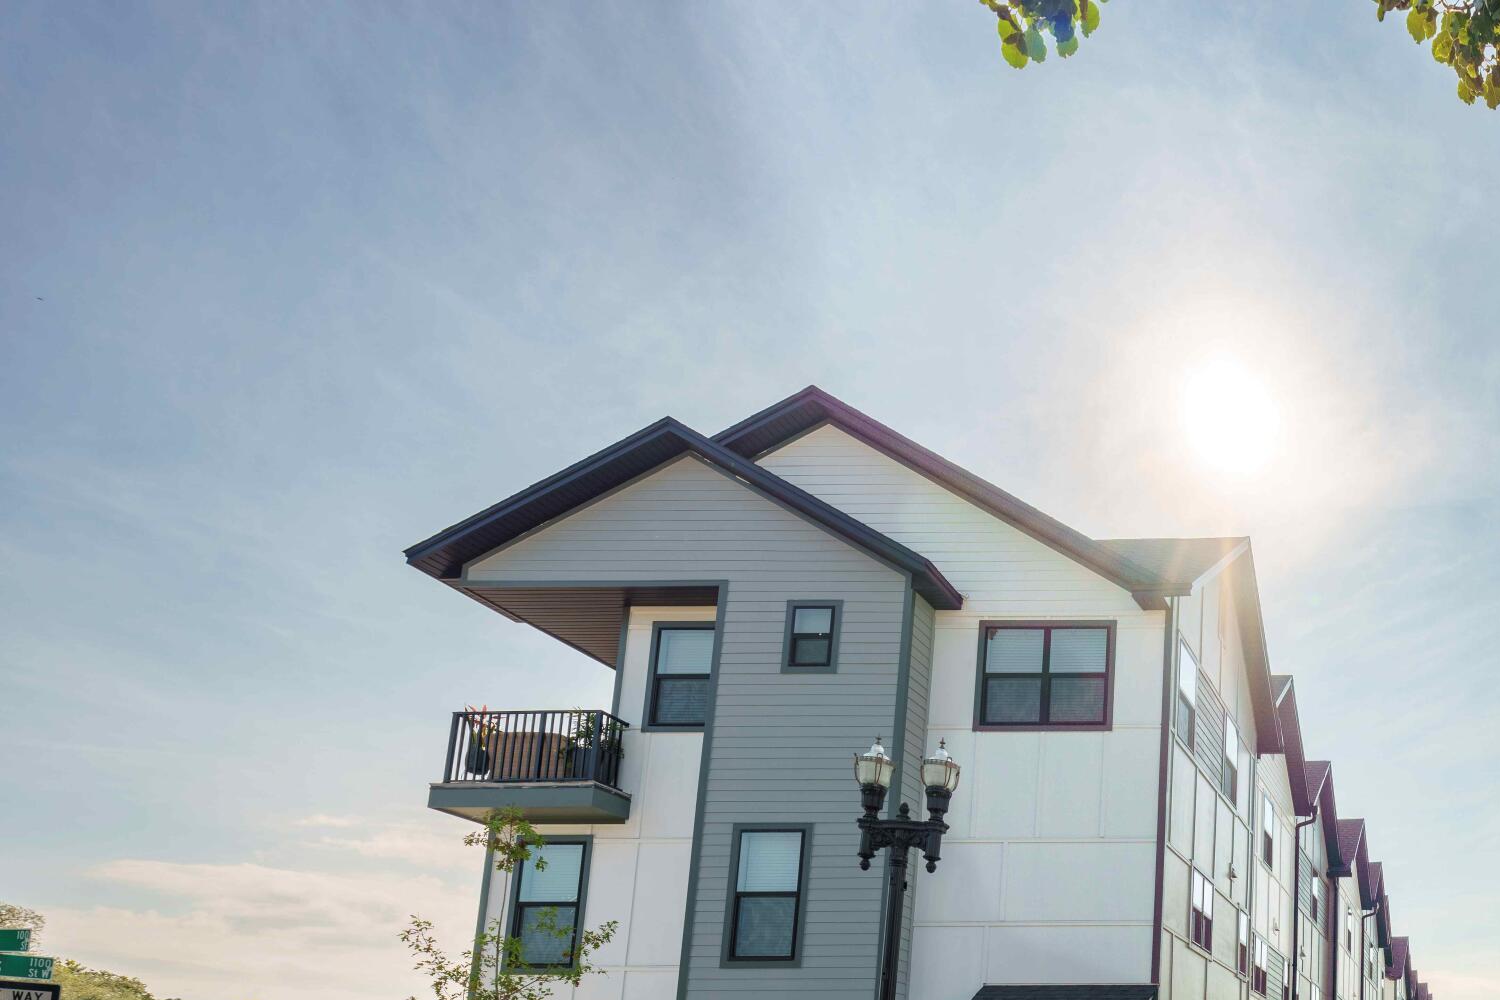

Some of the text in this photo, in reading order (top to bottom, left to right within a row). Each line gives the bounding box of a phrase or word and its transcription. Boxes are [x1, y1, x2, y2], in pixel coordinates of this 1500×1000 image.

[30, 958, 51, 968] 1100
[28, 968, 50, 978] St W
